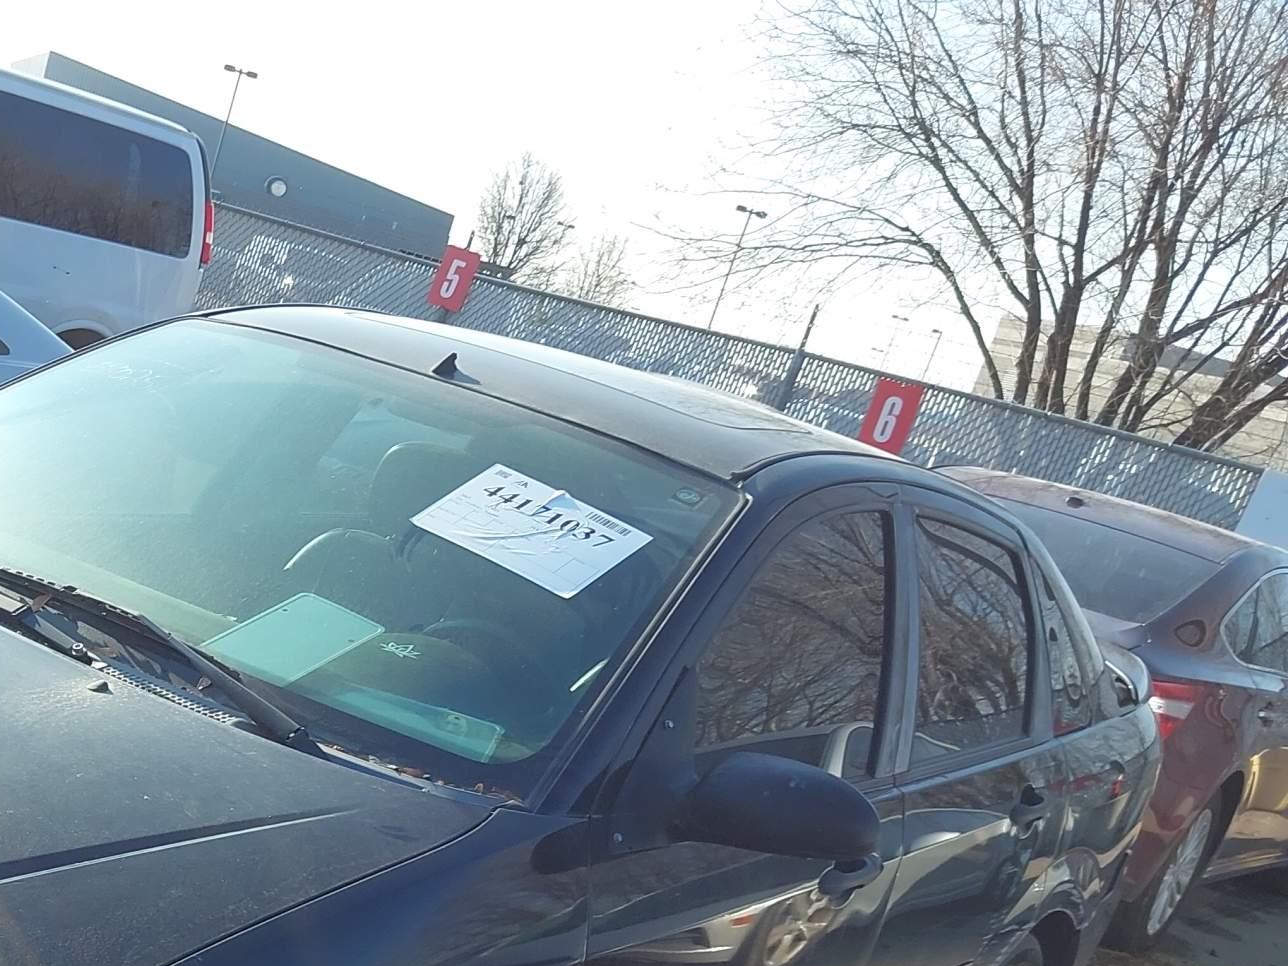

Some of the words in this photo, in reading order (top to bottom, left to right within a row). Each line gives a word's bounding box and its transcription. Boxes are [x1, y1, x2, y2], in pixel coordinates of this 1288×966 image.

[440, 260, 461, 299] 5
[873, 397, 901, 442] 6
[483, 485, 616, 548] 44171037
